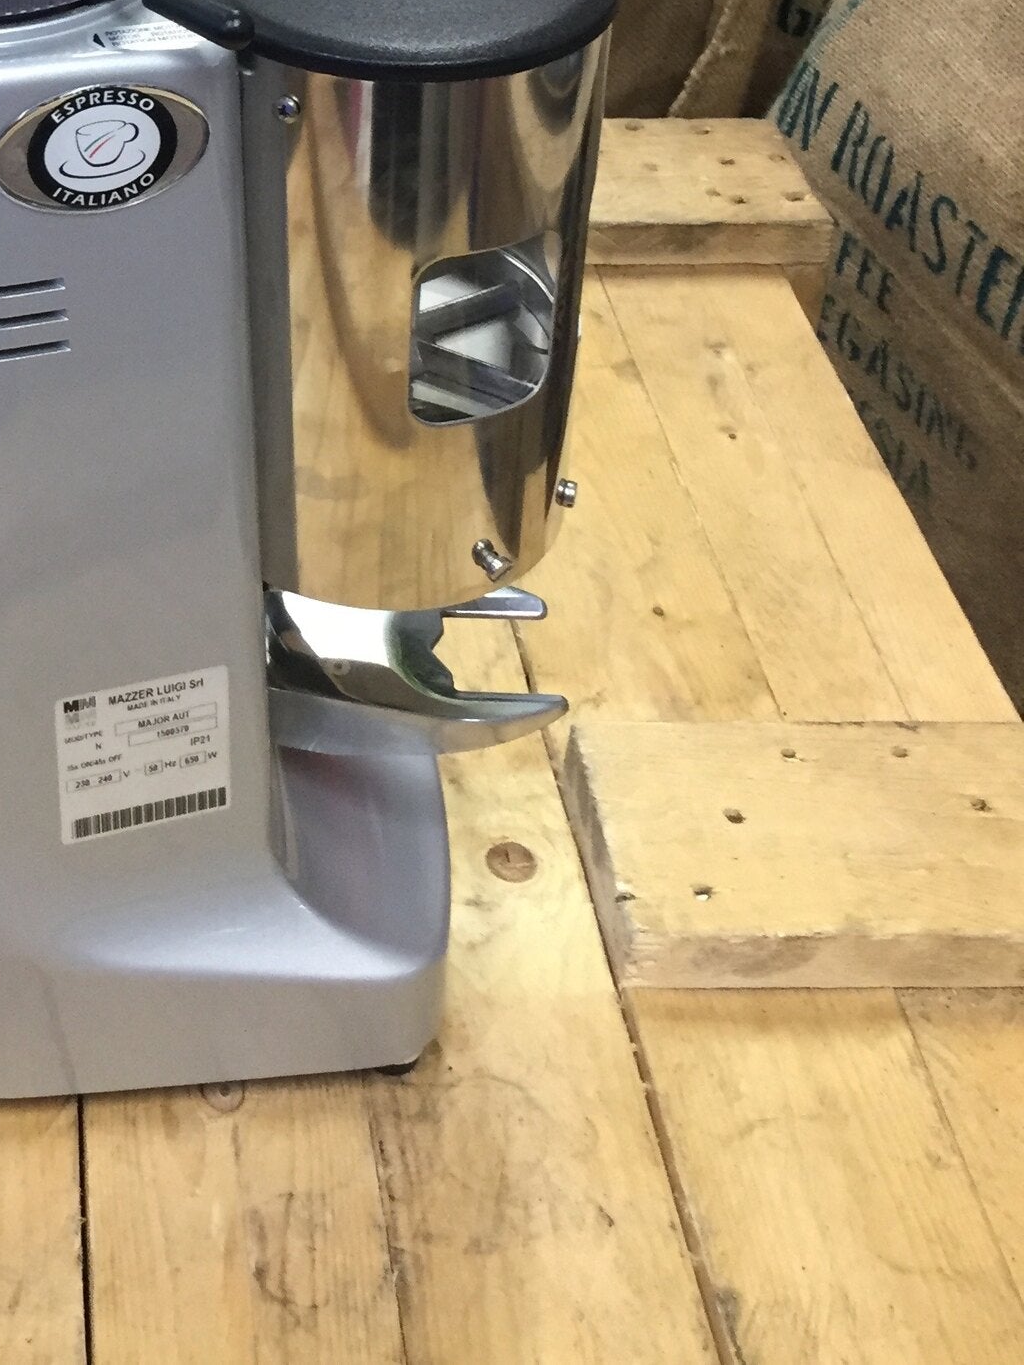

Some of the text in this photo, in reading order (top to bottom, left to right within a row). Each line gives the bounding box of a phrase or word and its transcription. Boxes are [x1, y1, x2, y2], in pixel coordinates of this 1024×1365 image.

[50, 90, 155, 124] ESPRESSO
[52, 172, 155, 207] ITALIANO
[108, 687, 154, 706] MAZZER
[157, 680, 187, 696] LUIGI
[189, 677, 205, 690] Srl
[127, 694, 182, 712] MADE IN ITALY
[137, 714, 171, 729] MAJOR
[190, 734, 212, 747] IP21
